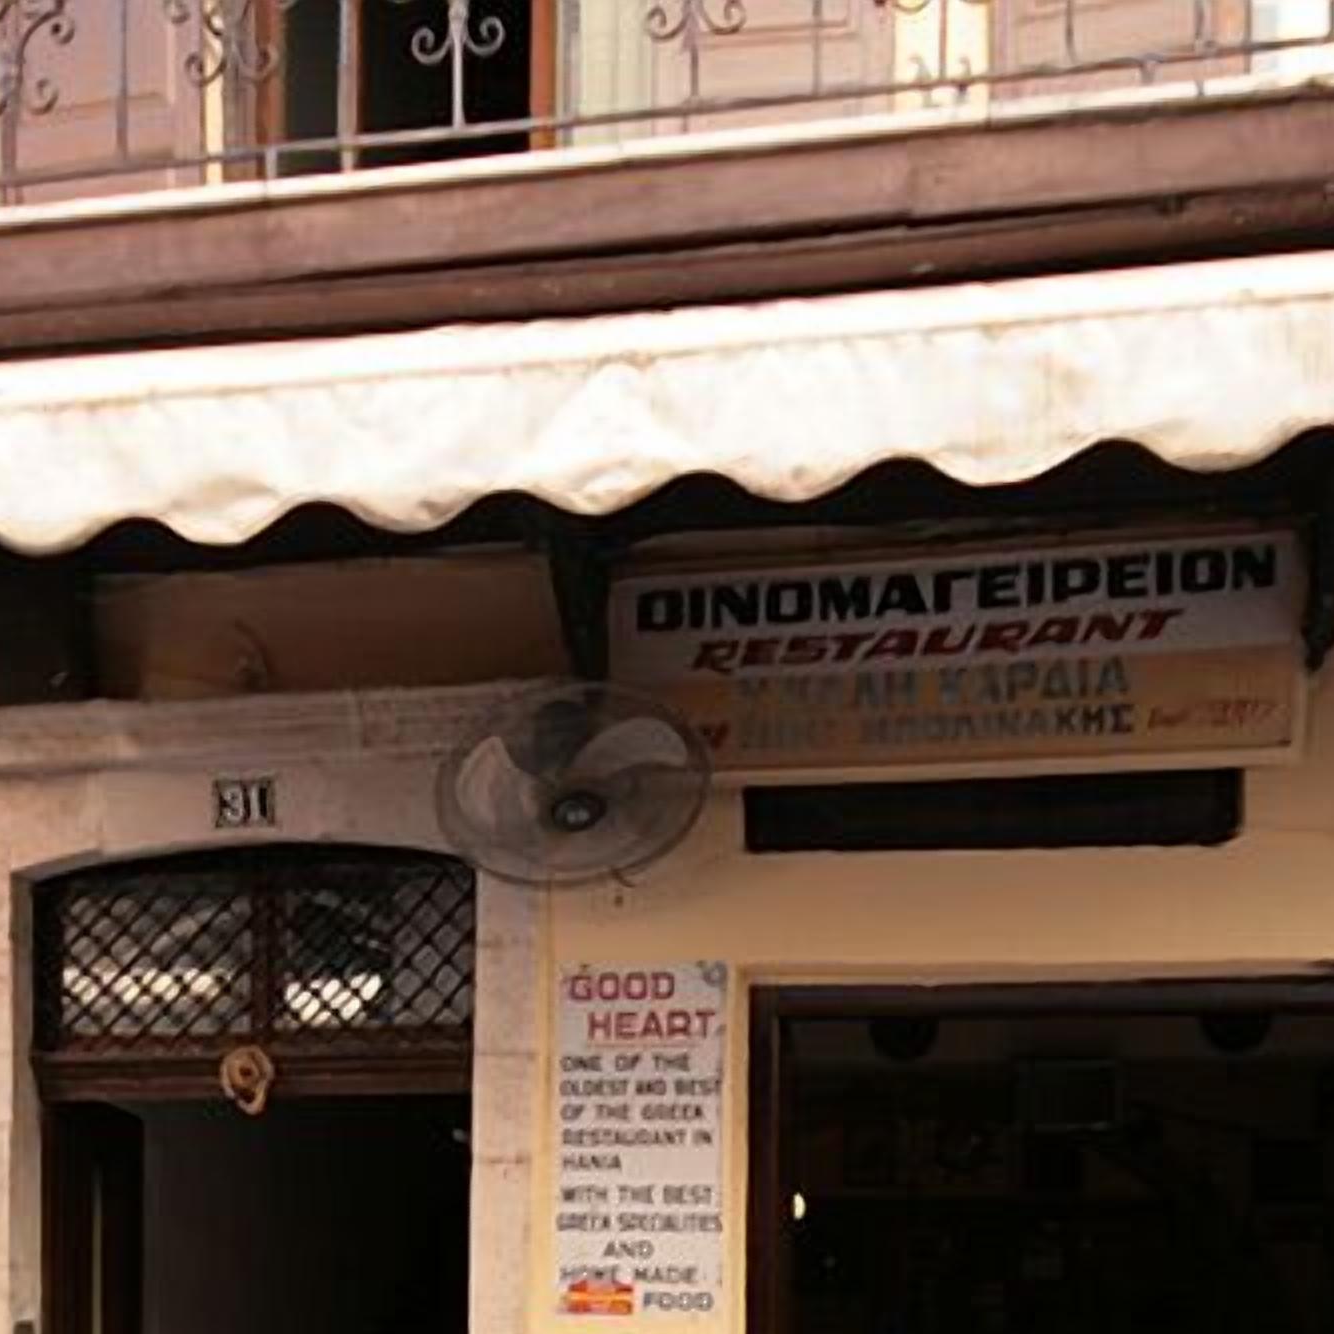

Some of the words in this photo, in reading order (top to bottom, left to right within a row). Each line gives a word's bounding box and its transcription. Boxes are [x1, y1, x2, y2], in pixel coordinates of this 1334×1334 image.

[635, 543, 1278, 632] ΟΙΝΟΜΑΓΕΙΡΕΙΟΝ
[691, 607, 1186, 674] RESTAURANT
[221, 785, 261, 822] 31
[568, 971, 675, 1001] GOOD
[586, 1010, 715, 1041] HEART
[560, 1055, 602, 1072] ONE
[615, 1053, 641, 1072] OF
[653, 1053, 690, 1072] THE
[560, 1079, 629, 1096] OLDEST
[674, 1078, 722, 1096] BEST
[560, 1104, 585, 1121] OF
[594, 1103, 630, 1120] THE
[561, 1185, 609, 1204] WITH
[618, 1185, 654, 1203] THE
[663, 1185, 712, 1204] BEST
[603, 1240, 655, 1258] AND
[633, 1266, 697, 1284] MADE
[643, 1292, 714, 1312] FOOD
